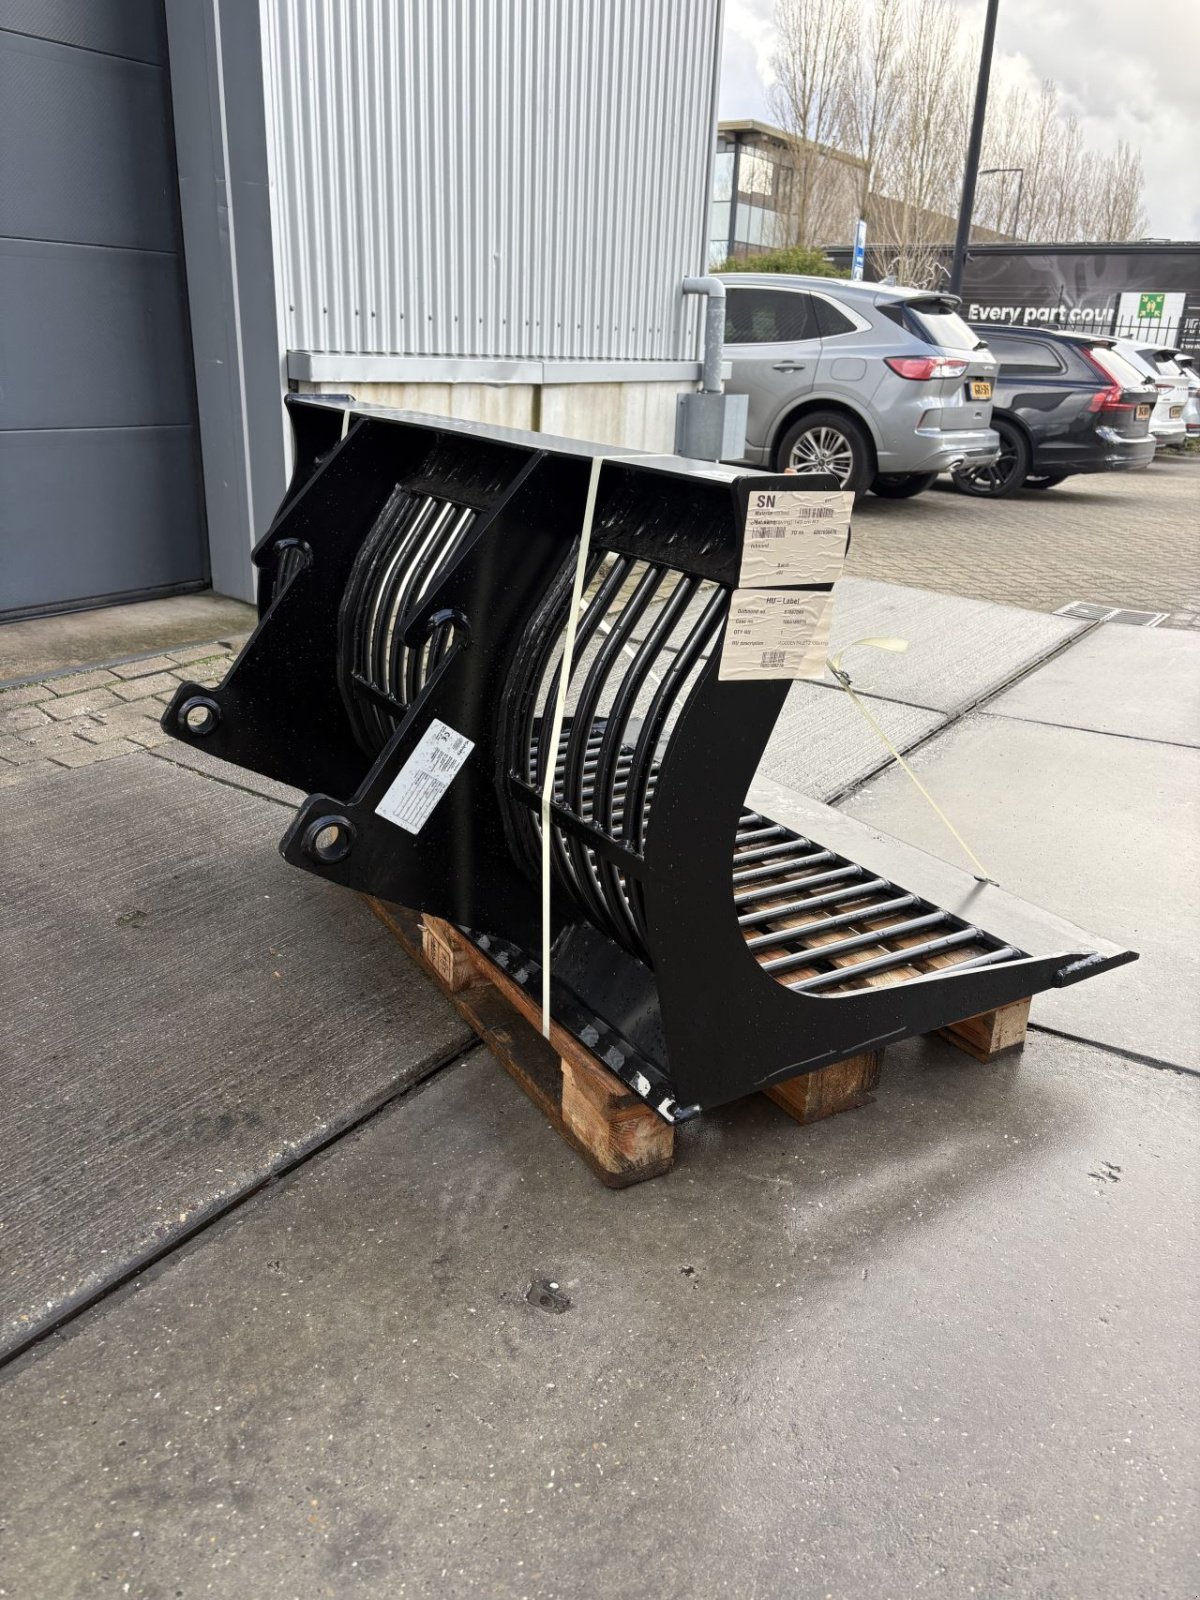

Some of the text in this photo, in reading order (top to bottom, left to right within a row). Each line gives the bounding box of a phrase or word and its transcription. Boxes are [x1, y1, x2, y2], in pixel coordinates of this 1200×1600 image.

[968, 304, 1021, 326] Every
[1024, 304, 1066, 326] part
[757, 494, 776, 508] SN
